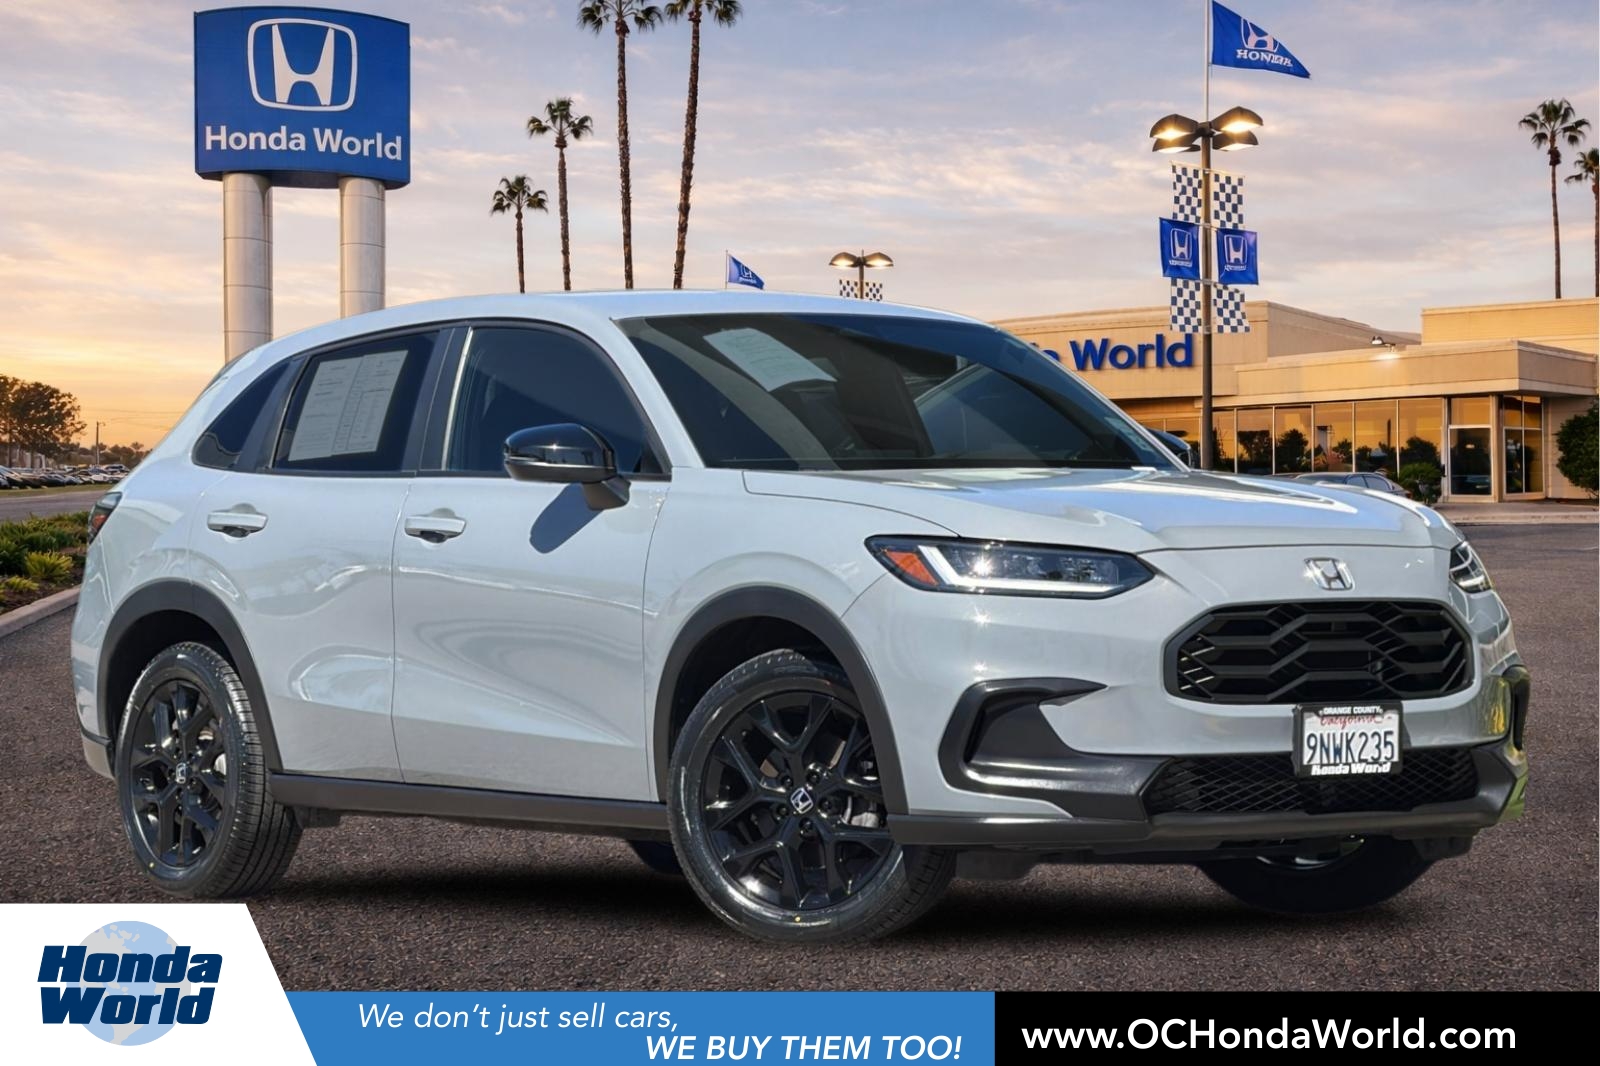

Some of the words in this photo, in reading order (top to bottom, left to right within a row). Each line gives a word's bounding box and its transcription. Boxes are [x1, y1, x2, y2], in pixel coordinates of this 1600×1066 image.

[205, 125, 306, 151] Honda
[313, 127, 402, 161] World
[1069, 333, 1193, 371] World
[1323, 706, 1352, 715] ORANGE
[1353, 706, 1382, 714] COUNTY
[1306, 730, 1395, 764] 9NWK235
[1311, 763, 1350, 775] Honda
[1350, 761, 1392, 775] World
